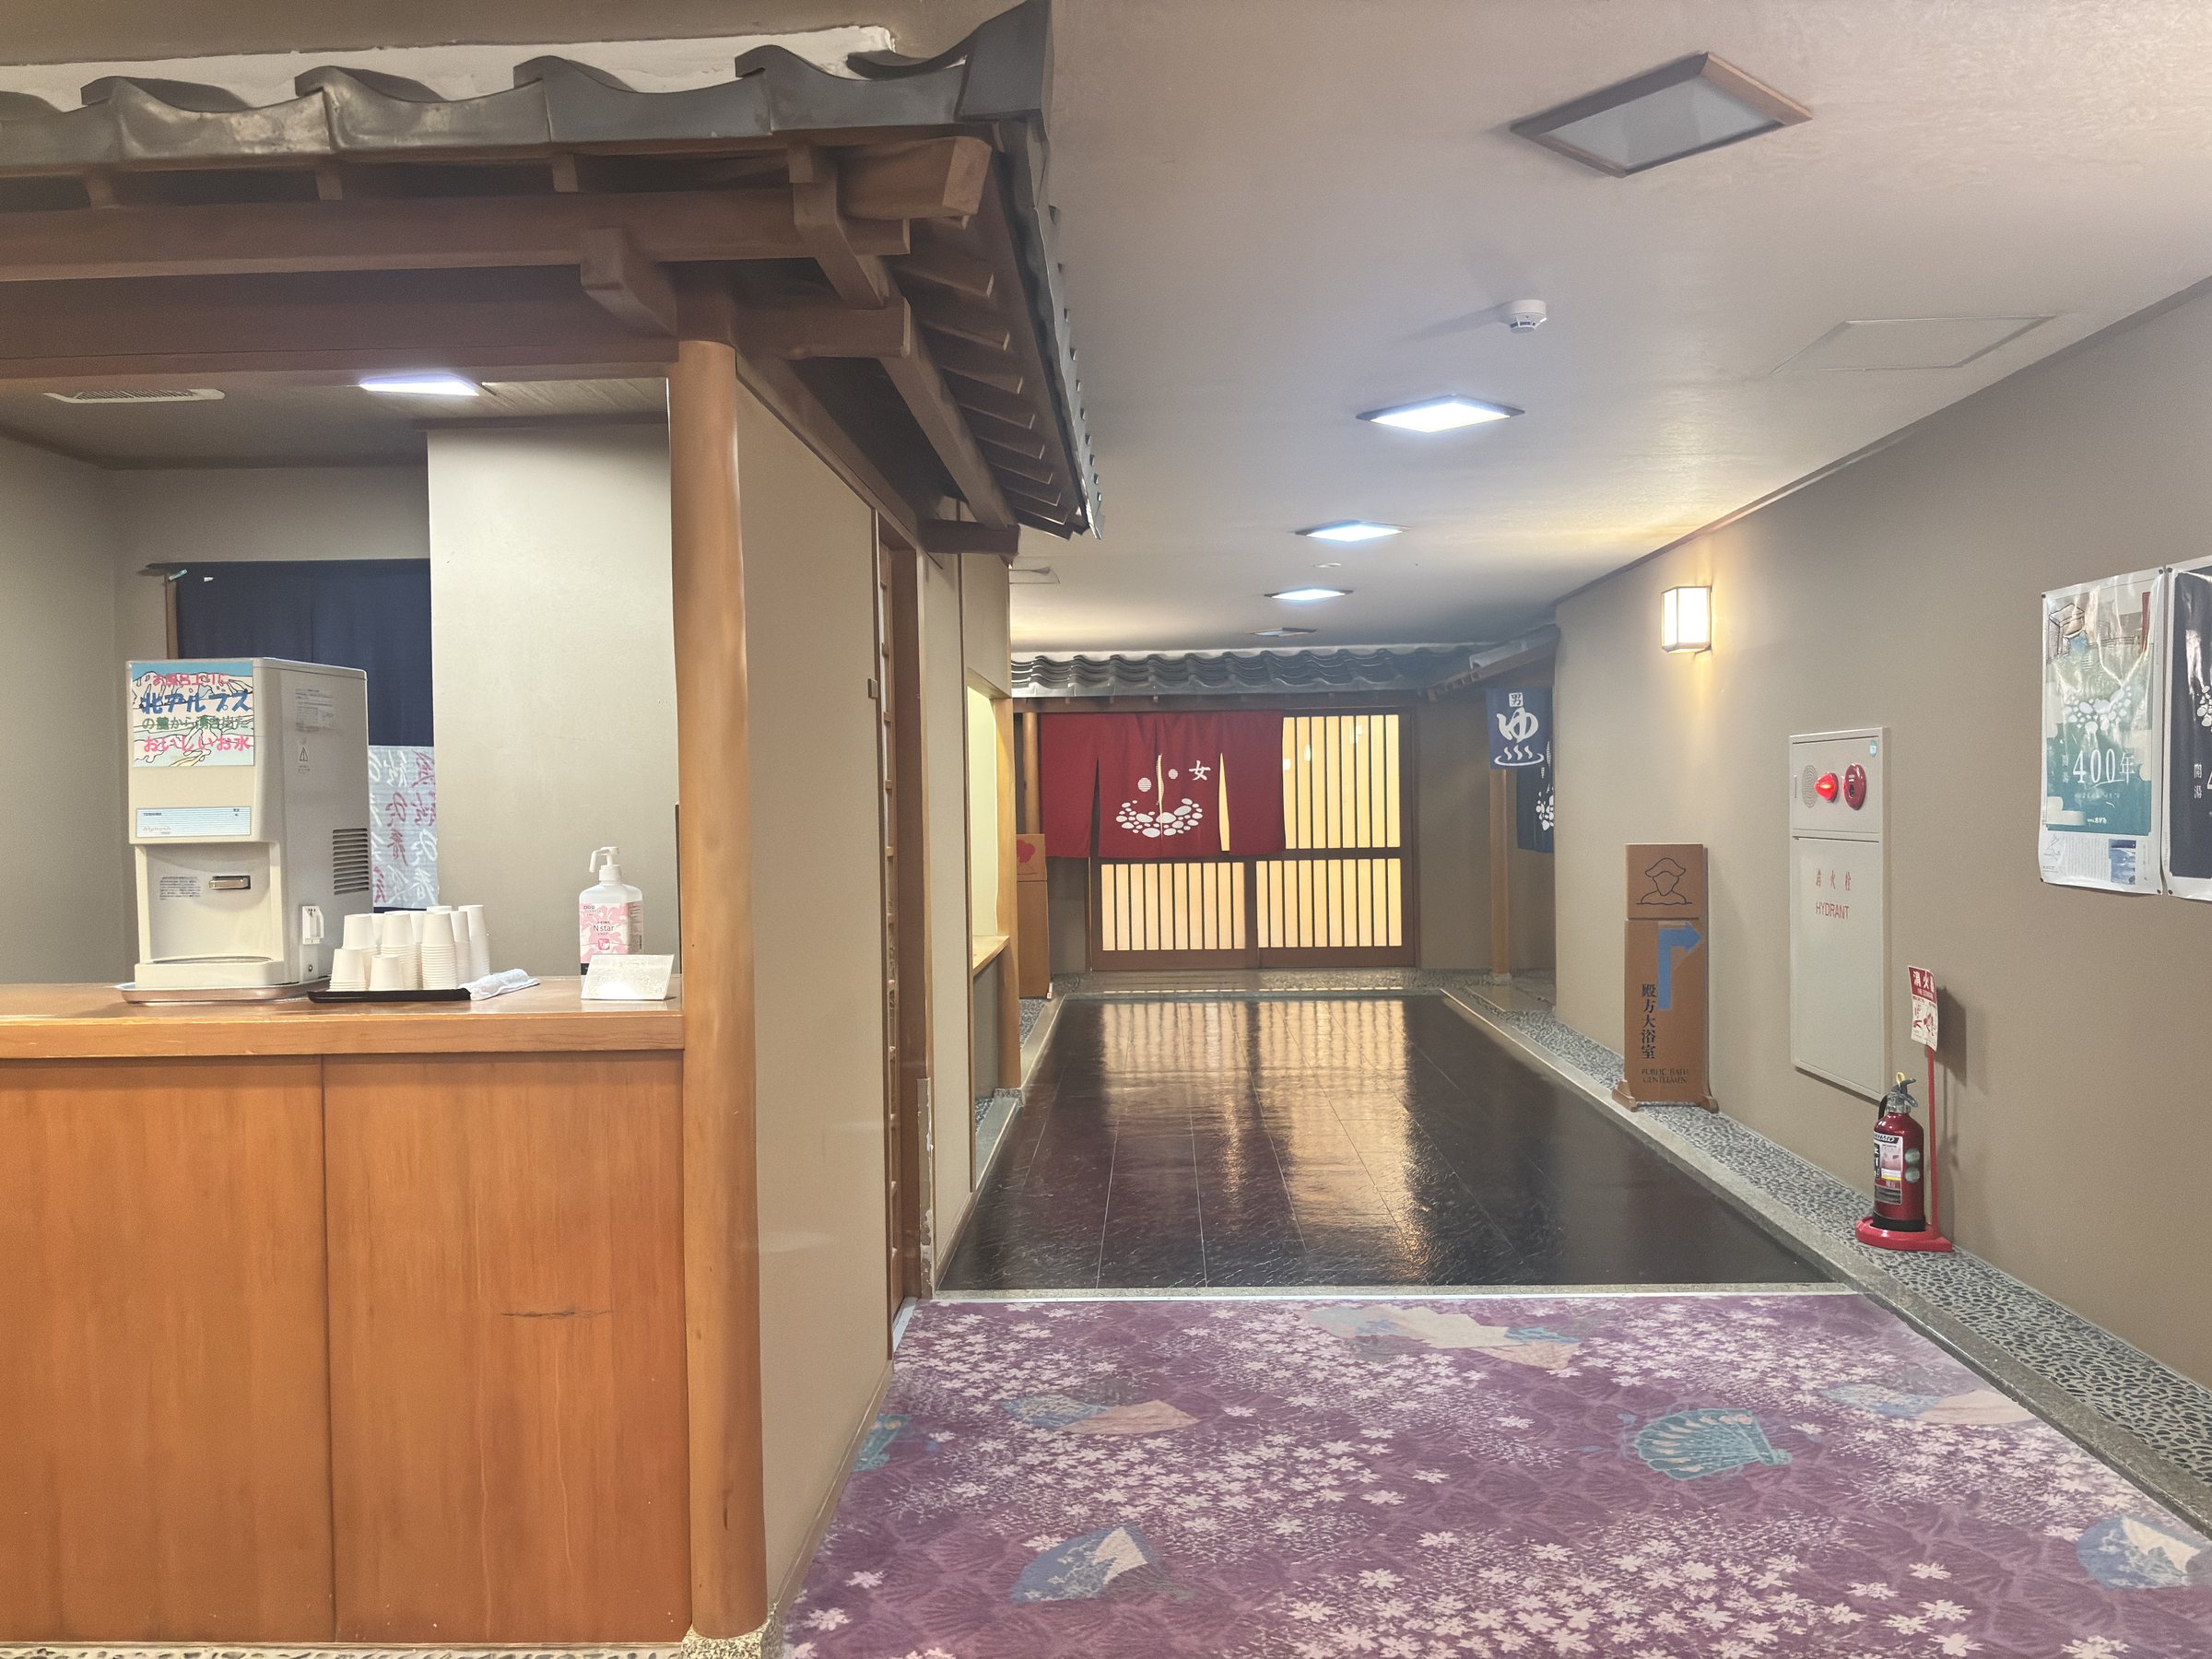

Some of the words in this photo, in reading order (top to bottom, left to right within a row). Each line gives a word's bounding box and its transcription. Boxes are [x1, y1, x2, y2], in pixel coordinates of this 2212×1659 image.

[141, 692, 250, 714] 北アルプス
[1496, 707, 1539, 743] ゆ
[143, 737, 250, 752] おいしいお水
[1189, 760, 1211, 781] 女
[2073, 748, 2136, 784] 400年
[1816, 868, 1851, 891] 消火栓
[1816, 900, 1850, 920] HYDRANT
[1641, 983, 1656, 1059] 殿方大浴室
